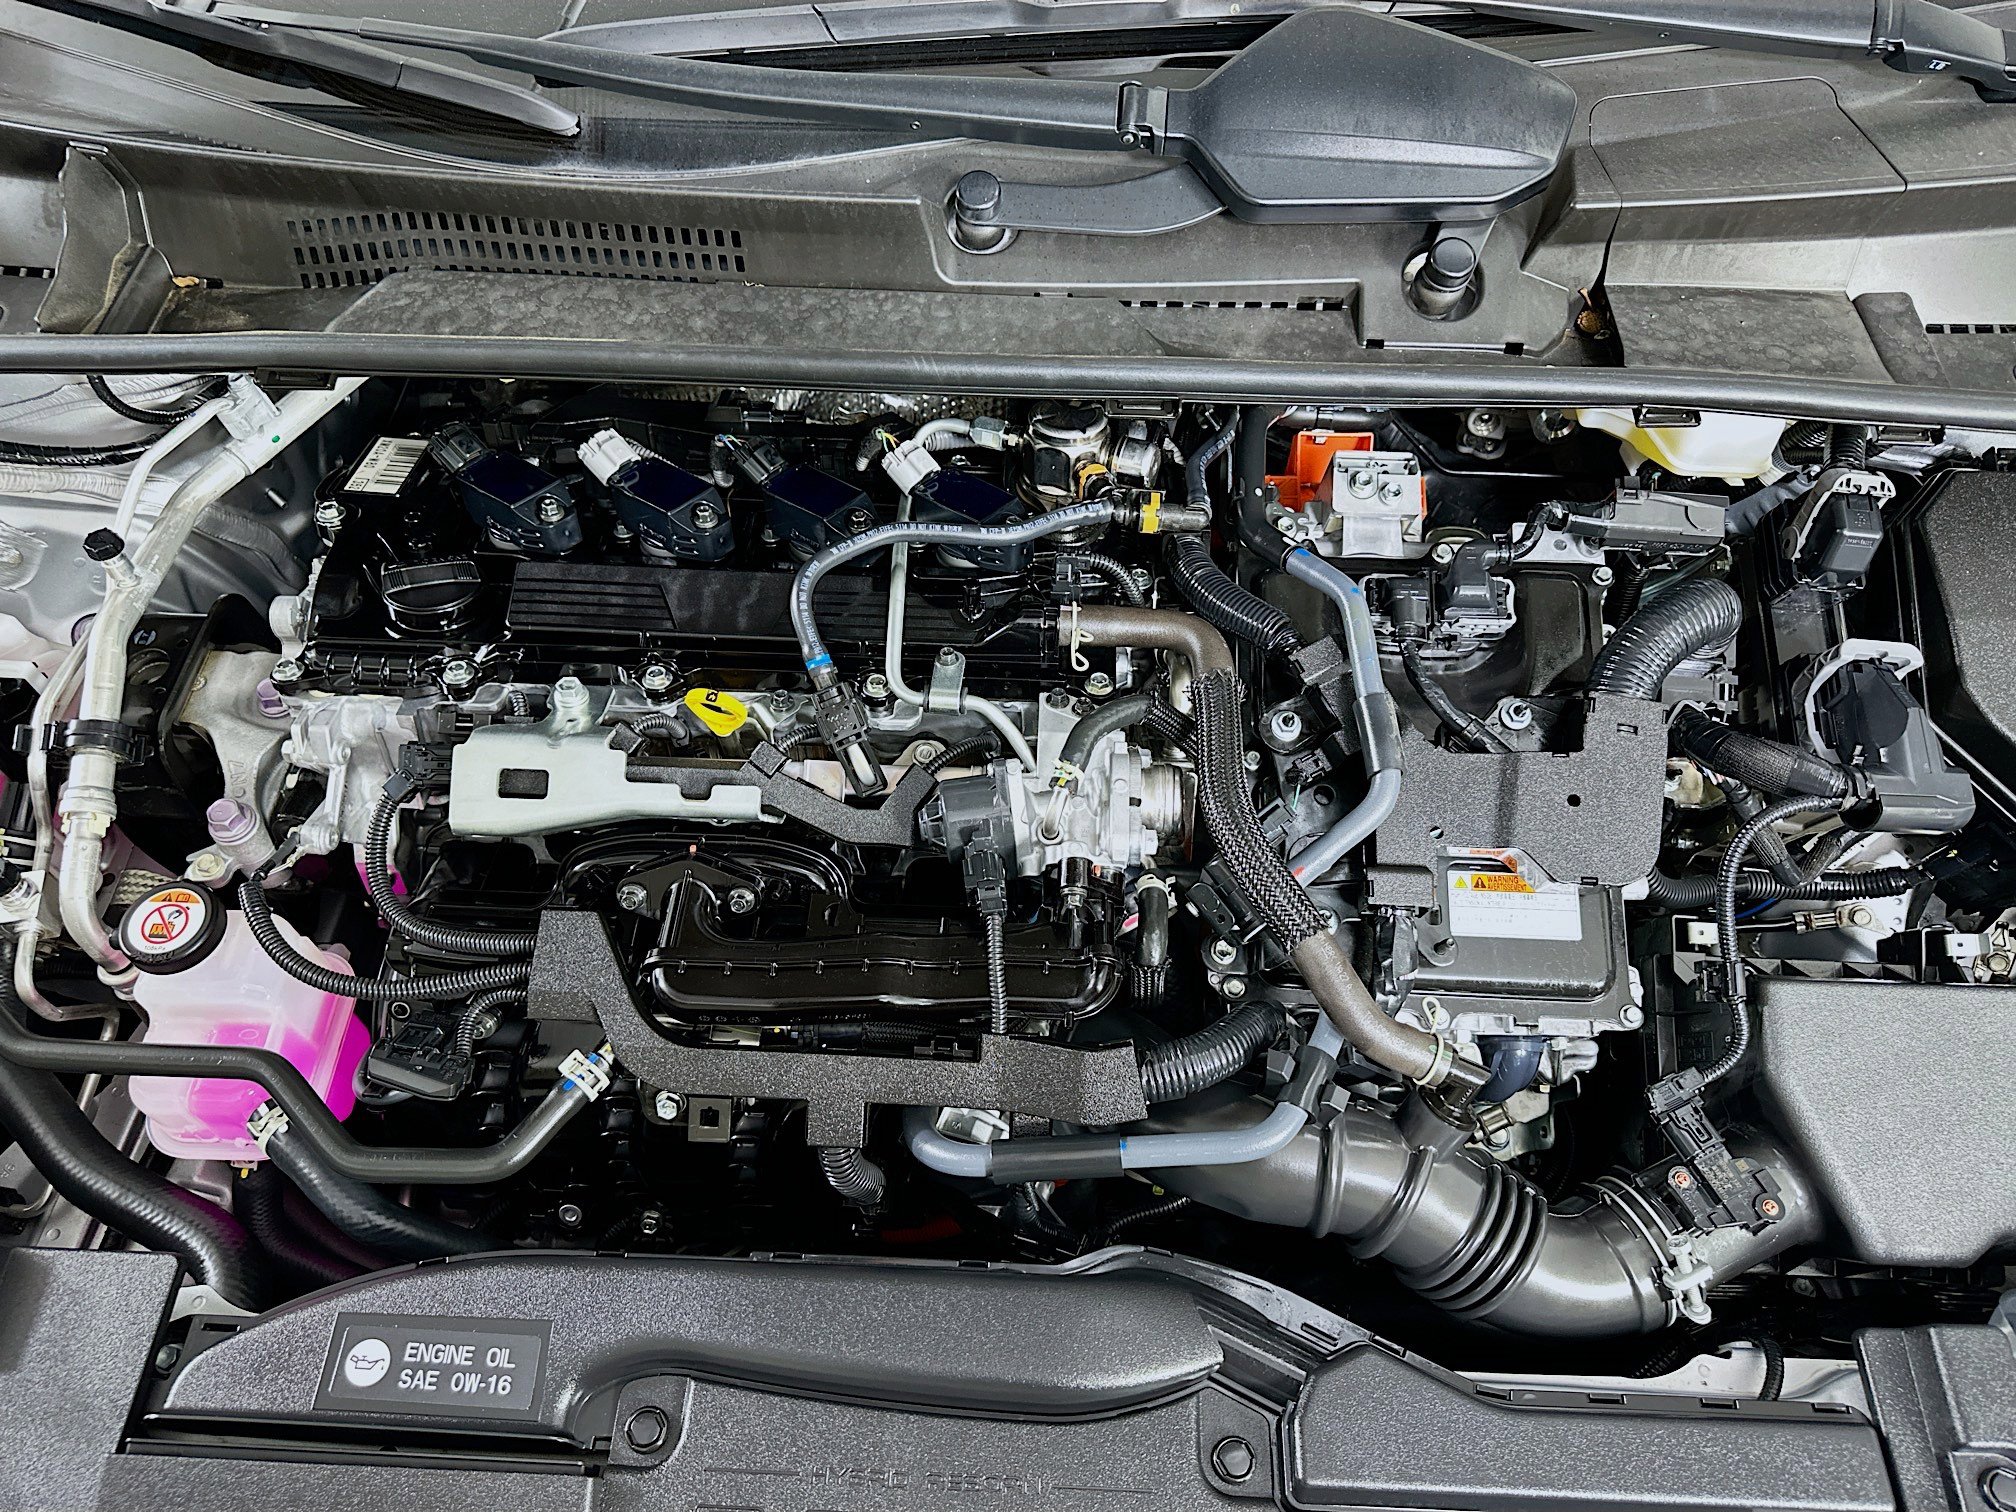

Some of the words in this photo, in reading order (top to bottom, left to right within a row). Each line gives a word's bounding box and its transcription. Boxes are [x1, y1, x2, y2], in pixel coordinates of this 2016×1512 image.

[1487, 875, 1519, 884] WARNING
[1487, 883, 1527, 892] AVERTISSEMENT
[403, 1342, 476, 1366] ENGINE
[486, 1347, 516, 1368] OIL
[398, 1369, 440, 1391] SAE
[451, 1372, 513, 1395] 0W-16
[925, 1471, 1042, 1495] REBORN
